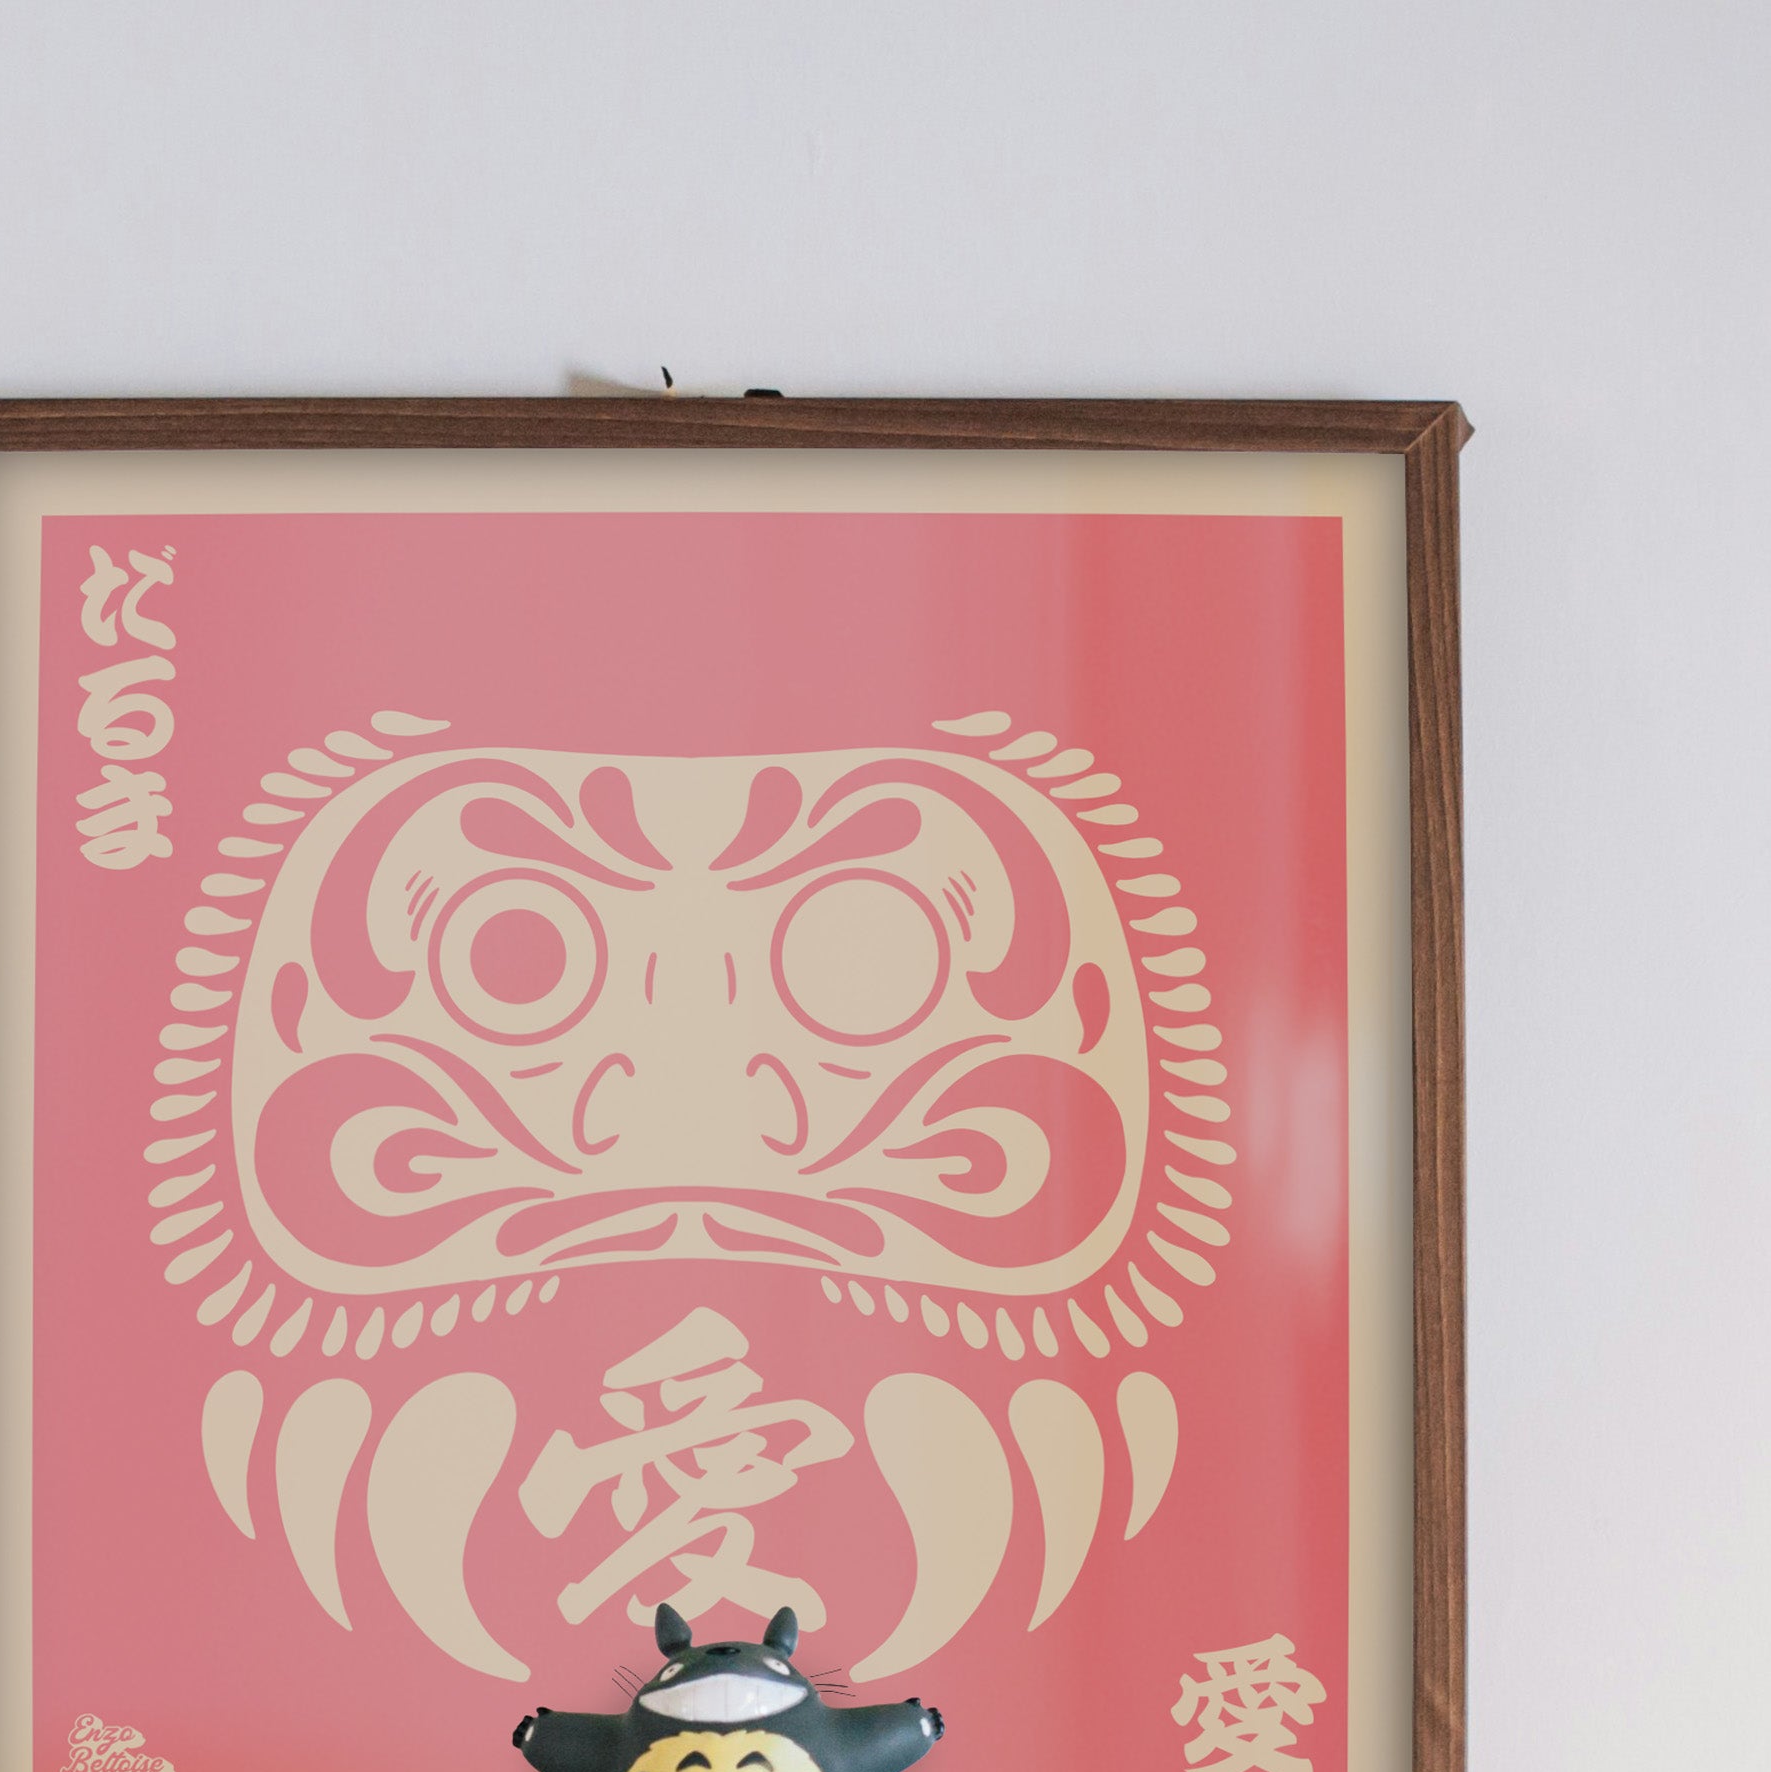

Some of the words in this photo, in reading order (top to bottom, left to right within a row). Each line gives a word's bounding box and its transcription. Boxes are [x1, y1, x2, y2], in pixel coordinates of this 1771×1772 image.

[76, 545, 177, 870] だるま
[518, 1306, 855, 1632] 愛
[69, 1714, 139, 1755] Enzo
